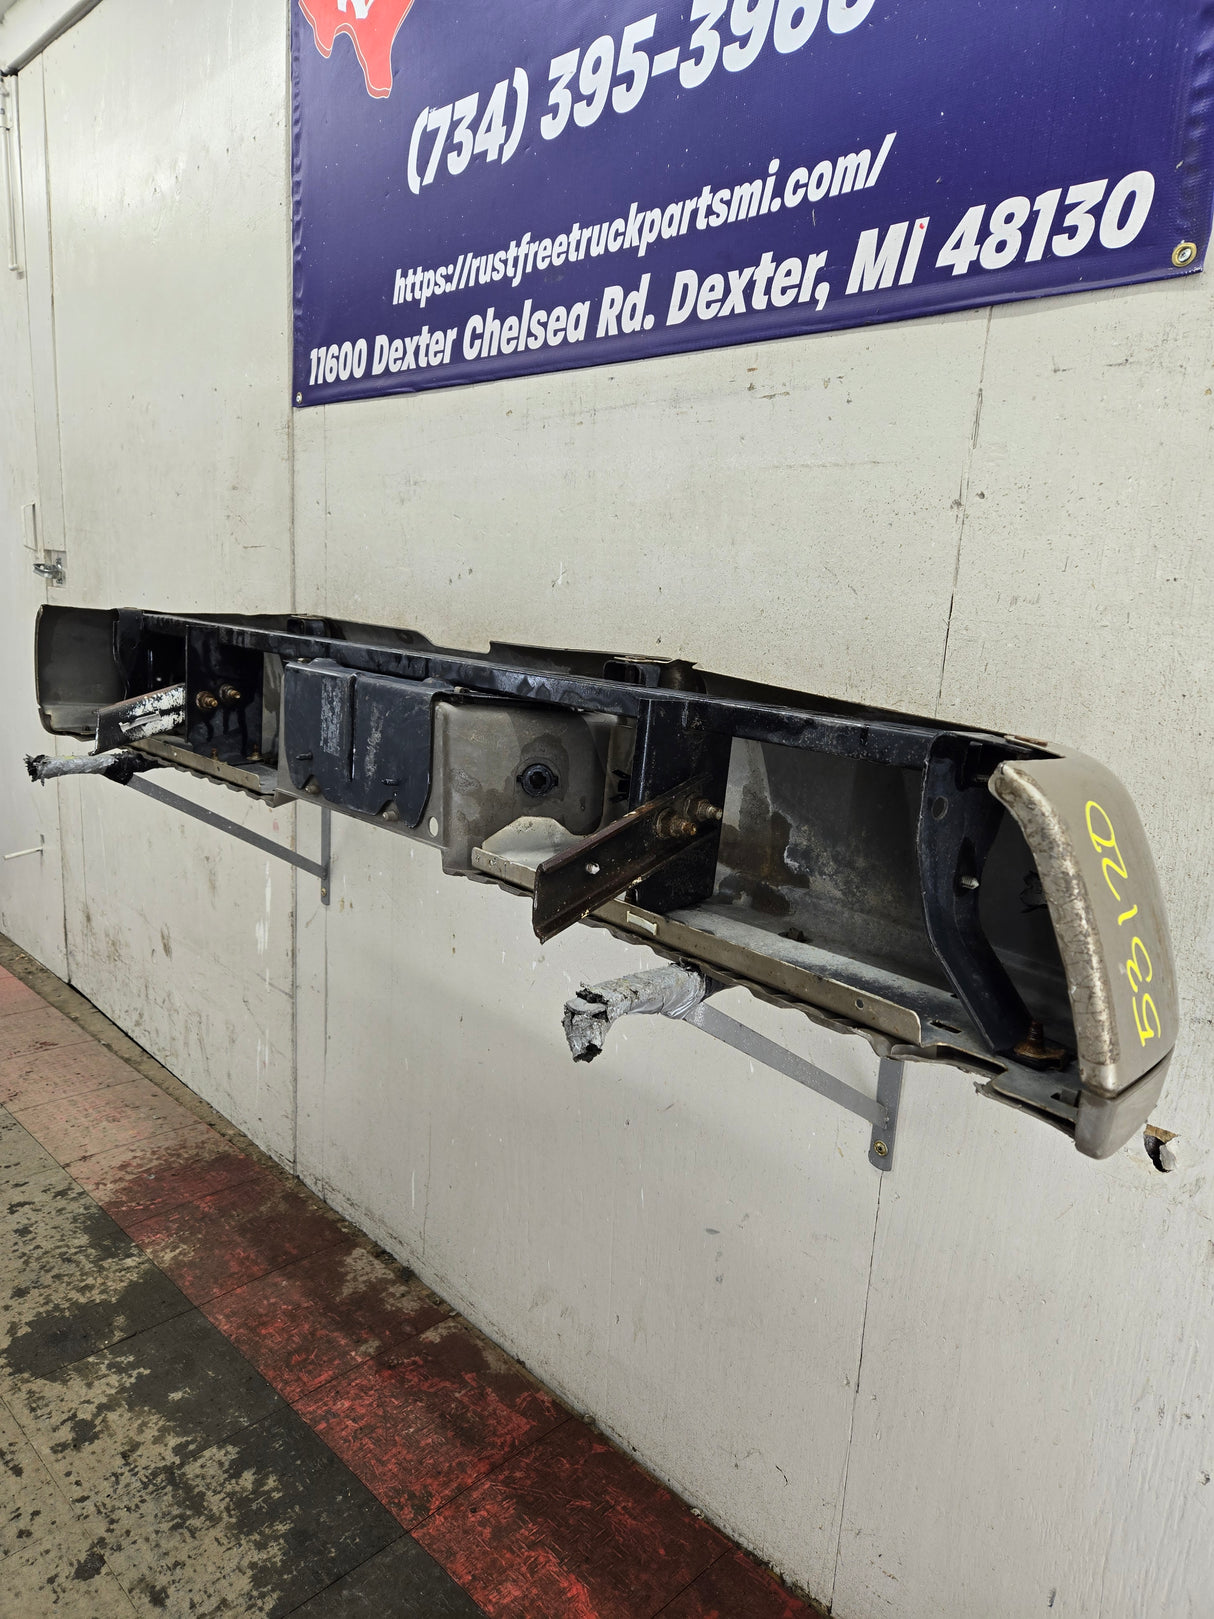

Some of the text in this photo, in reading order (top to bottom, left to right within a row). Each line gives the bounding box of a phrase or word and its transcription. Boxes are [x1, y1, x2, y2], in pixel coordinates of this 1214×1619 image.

[407, 67, 529, 195] (734)
[309, 170, 1155, 386] 11600 Dexter Chelsea Rd. Dexter, MI 48130
[392, 132, 897, 308] https://rustfreetruckpartsmi.com/
